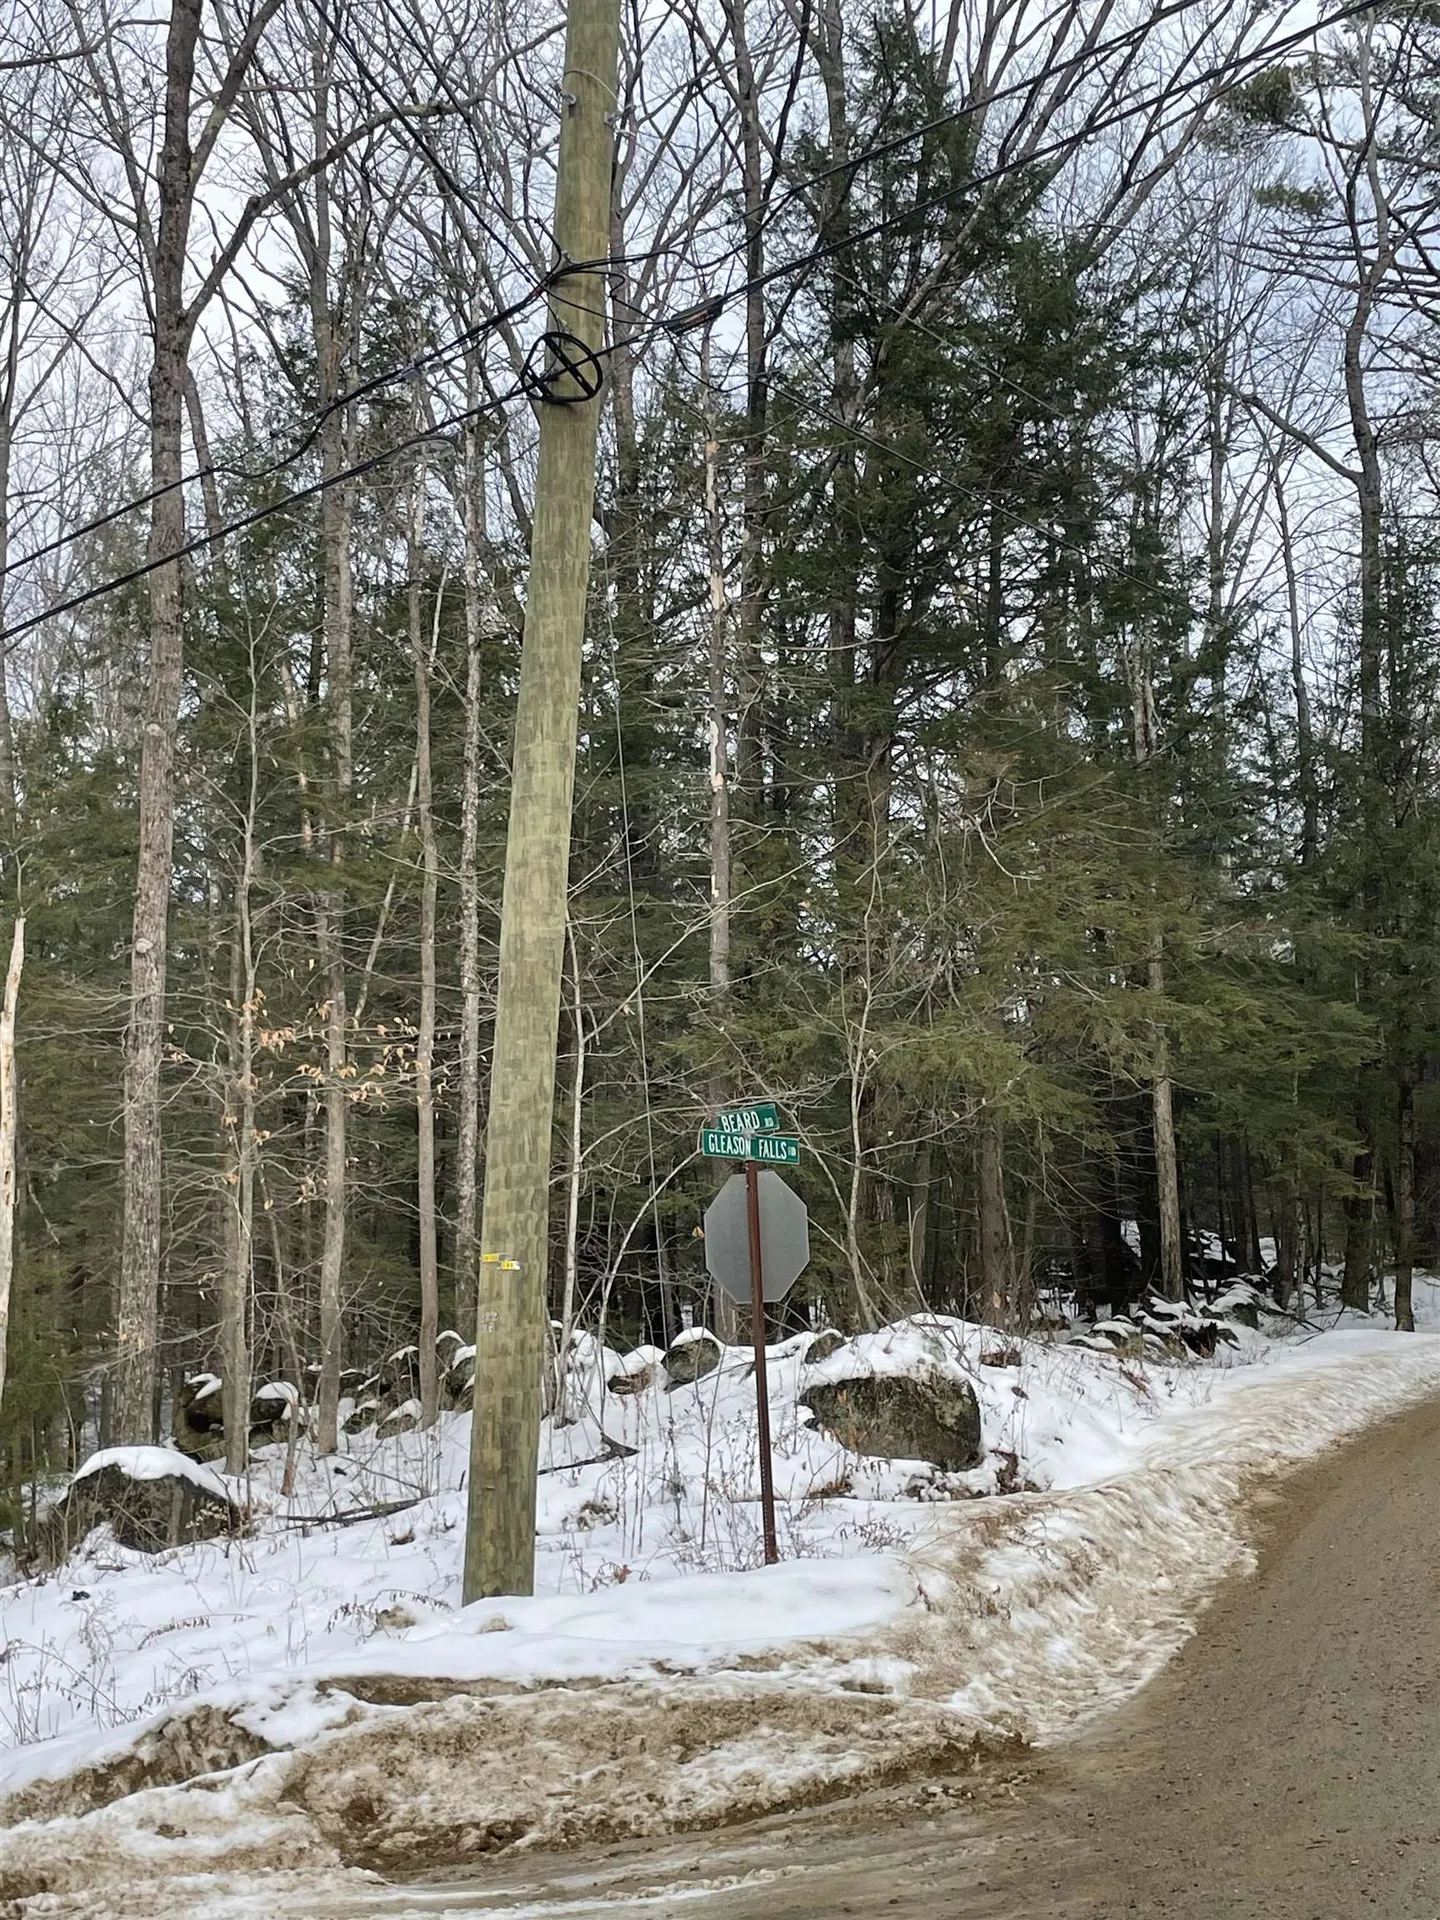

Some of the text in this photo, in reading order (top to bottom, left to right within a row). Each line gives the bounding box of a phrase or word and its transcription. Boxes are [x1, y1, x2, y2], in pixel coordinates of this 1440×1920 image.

[721, 1111, 774, 1133] BEARD RD
[708, 1133, 797, 1160] GLEASON FALLS RD
